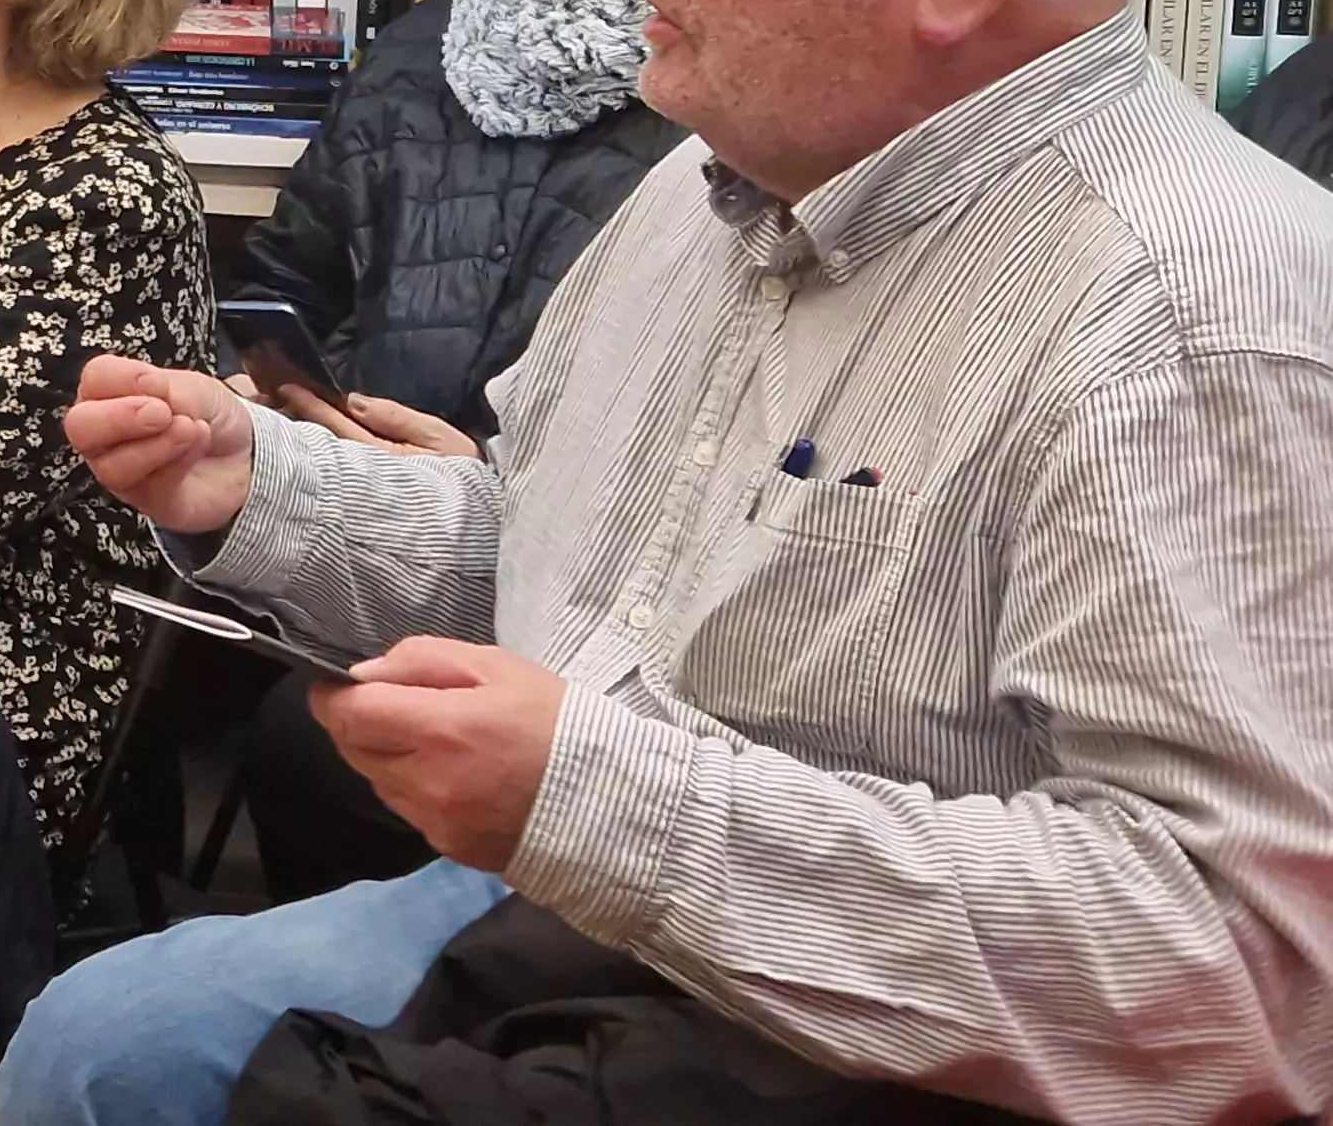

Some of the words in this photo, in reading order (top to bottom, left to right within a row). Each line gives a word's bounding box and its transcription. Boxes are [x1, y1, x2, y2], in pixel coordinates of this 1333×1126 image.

[1160, 39, 1172, 58] EN
[1197, 38, 1208, 57] EN
[1195, 61, 1206, 78] EL
